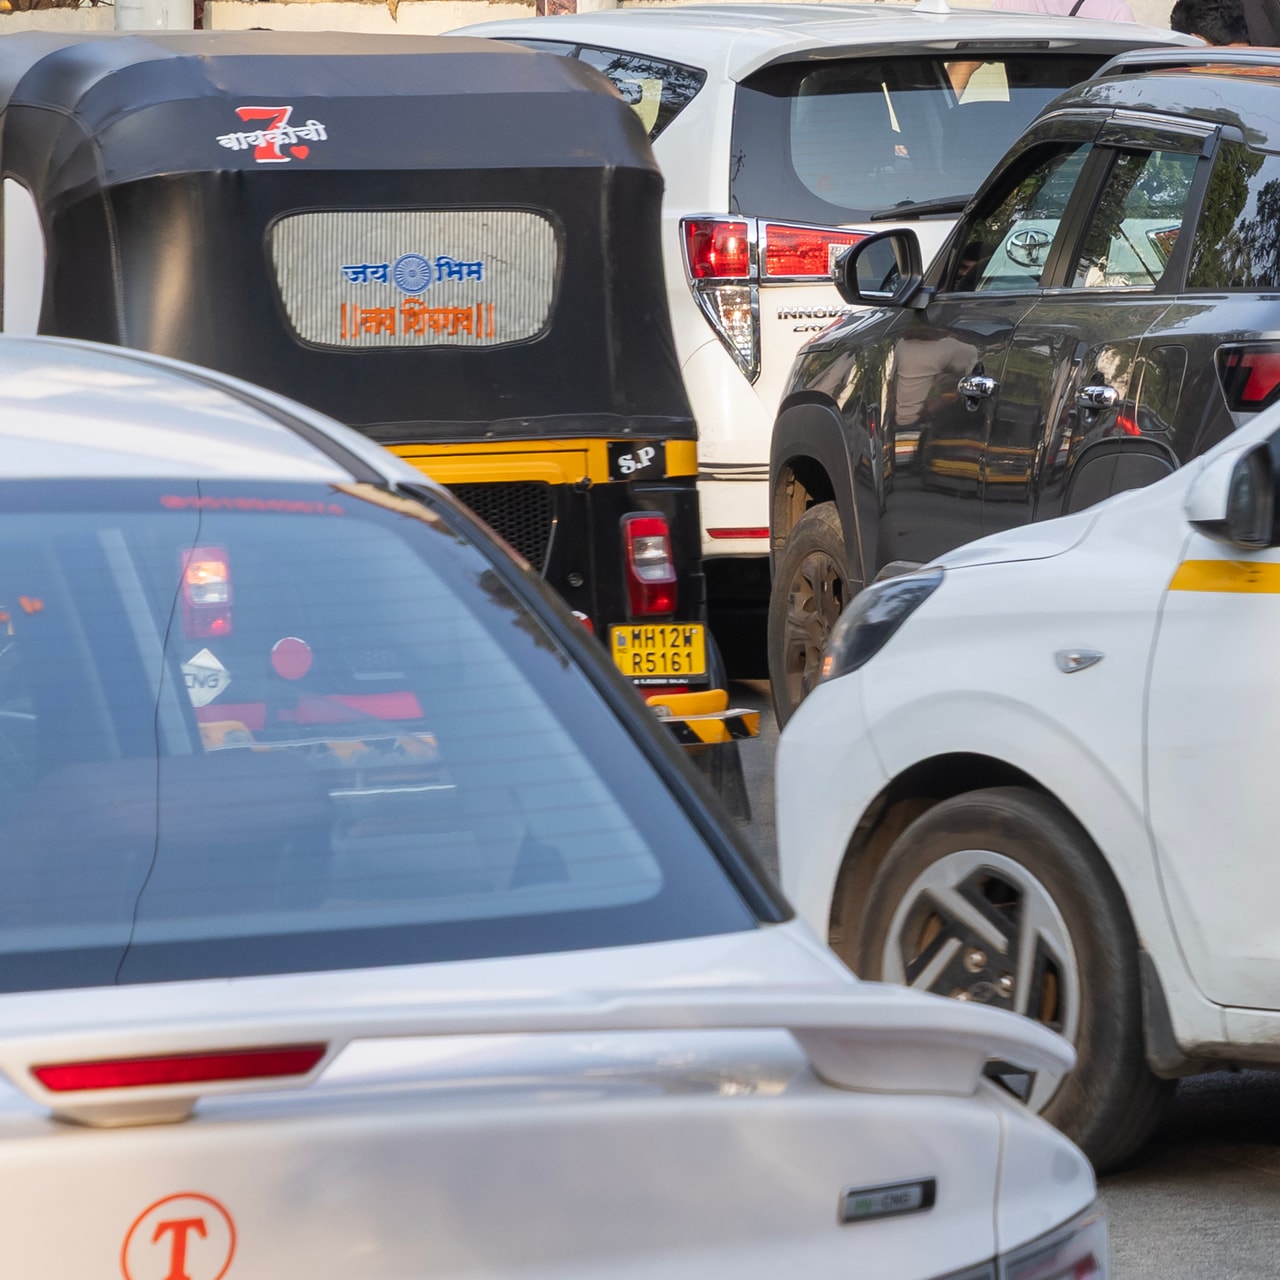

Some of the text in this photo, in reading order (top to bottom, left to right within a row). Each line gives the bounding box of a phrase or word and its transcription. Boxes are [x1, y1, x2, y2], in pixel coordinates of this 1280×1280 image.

[235, 106, 293, 163] 7
[341, 255, 484, 285] जय भिम
[777, 305, 852, 319] INNOVA
[618, 446, 656, 474] S.P
[632, 651, 693, 673] R5161
[151, 1218, 207, 1280] T
